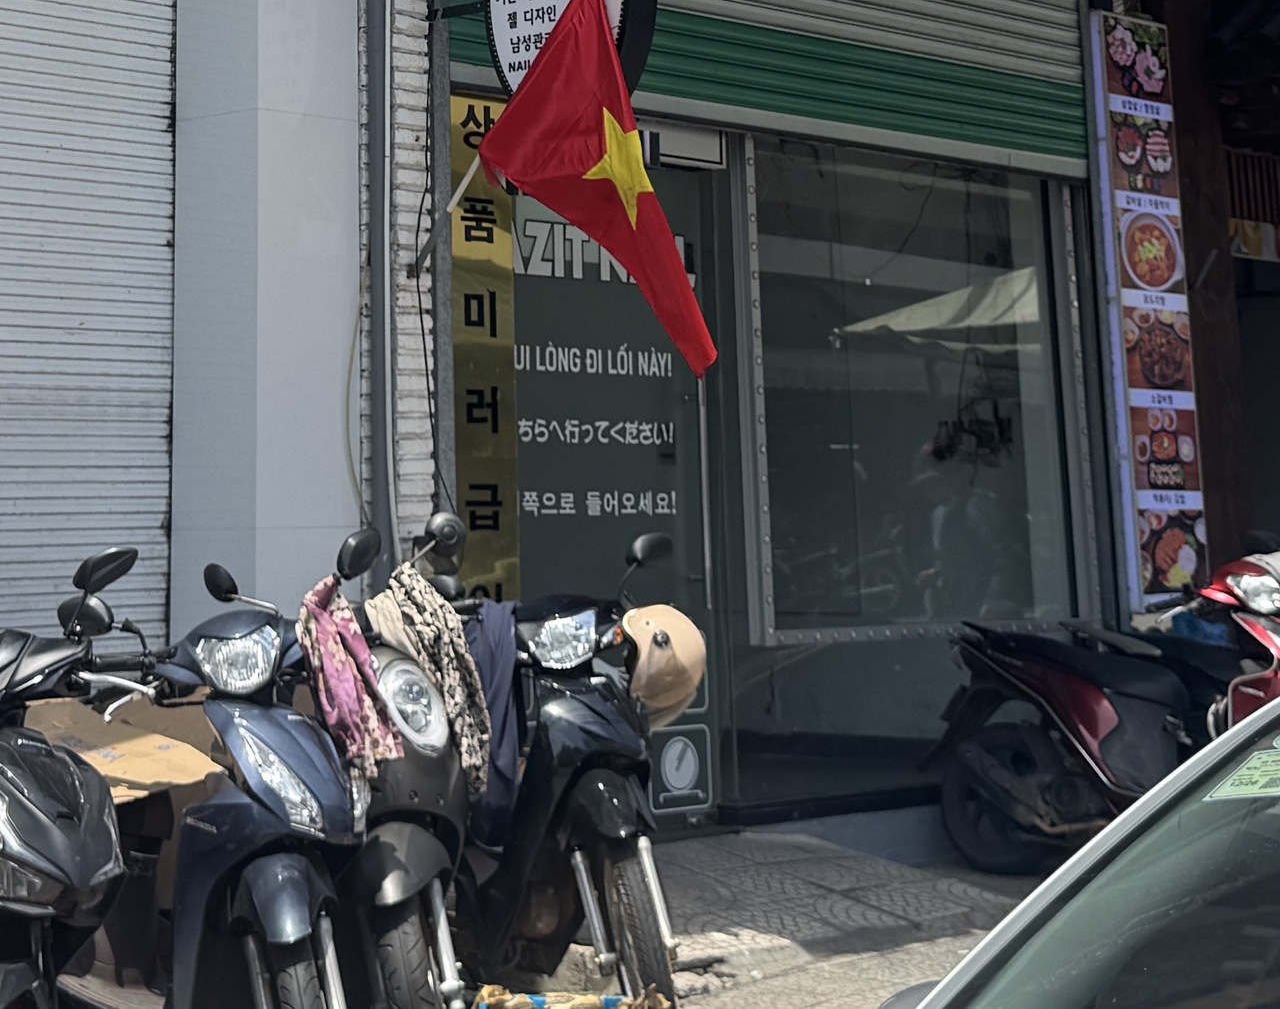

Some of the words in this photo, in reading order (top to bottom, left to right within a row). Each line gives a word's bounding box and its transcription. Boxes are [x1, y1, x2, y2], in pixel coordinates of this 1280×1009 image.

[507, 11, 518, 29] 젤
[523, 5, 557, 26] 디자인
[536, 341, 581, 373] LÒNG
[585, 348, 602, 374] ĐI
[608, 343, 633, 375] LỐI
[638, 347, 672, 377] NÀY!
[585, 490, 677, 517] 들어오세요!
